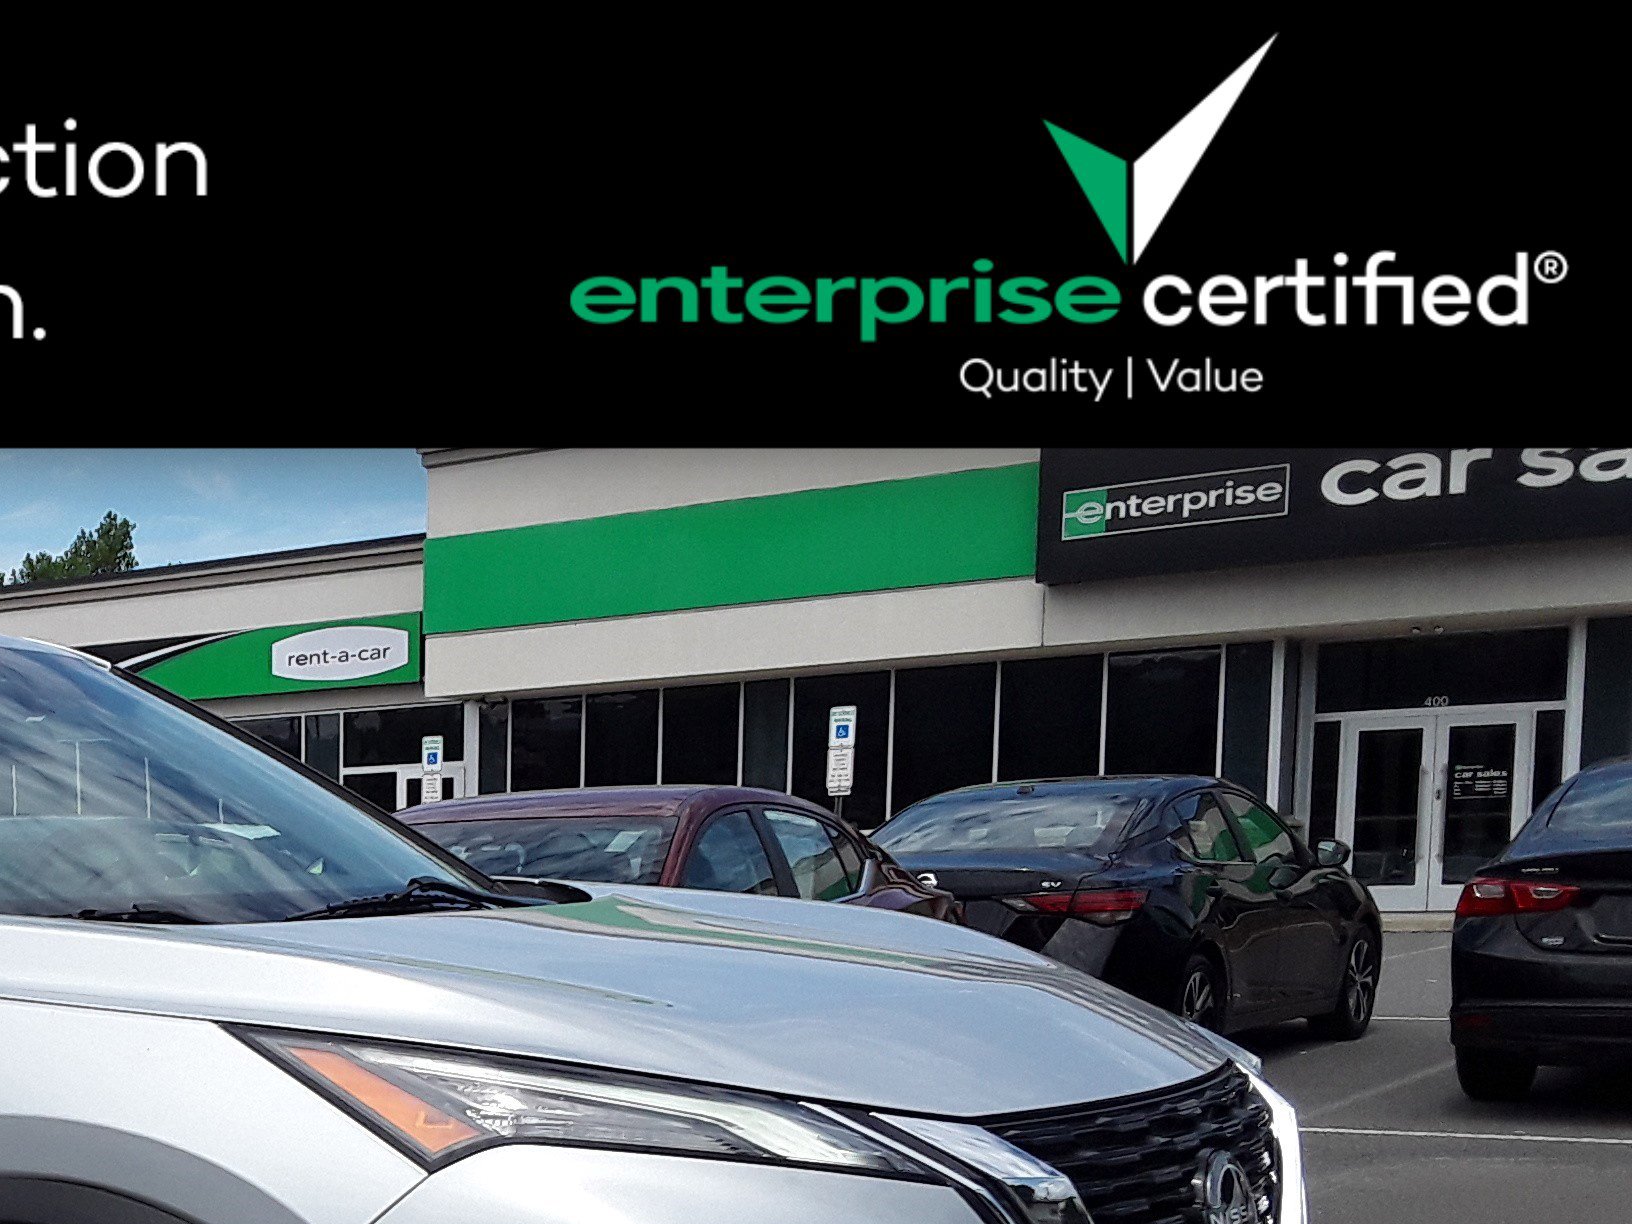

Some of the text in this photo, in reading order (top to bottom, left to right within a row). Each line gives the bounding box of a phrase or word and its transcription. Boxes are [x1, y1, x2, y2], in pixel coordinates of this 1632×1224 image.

[1320, 448, 1493, 506] car
[1076, 480, 1283, 524] enterprise
[287, 646, 391, 667] rent-a-car
[1424, 695, 1449, 707] 400
